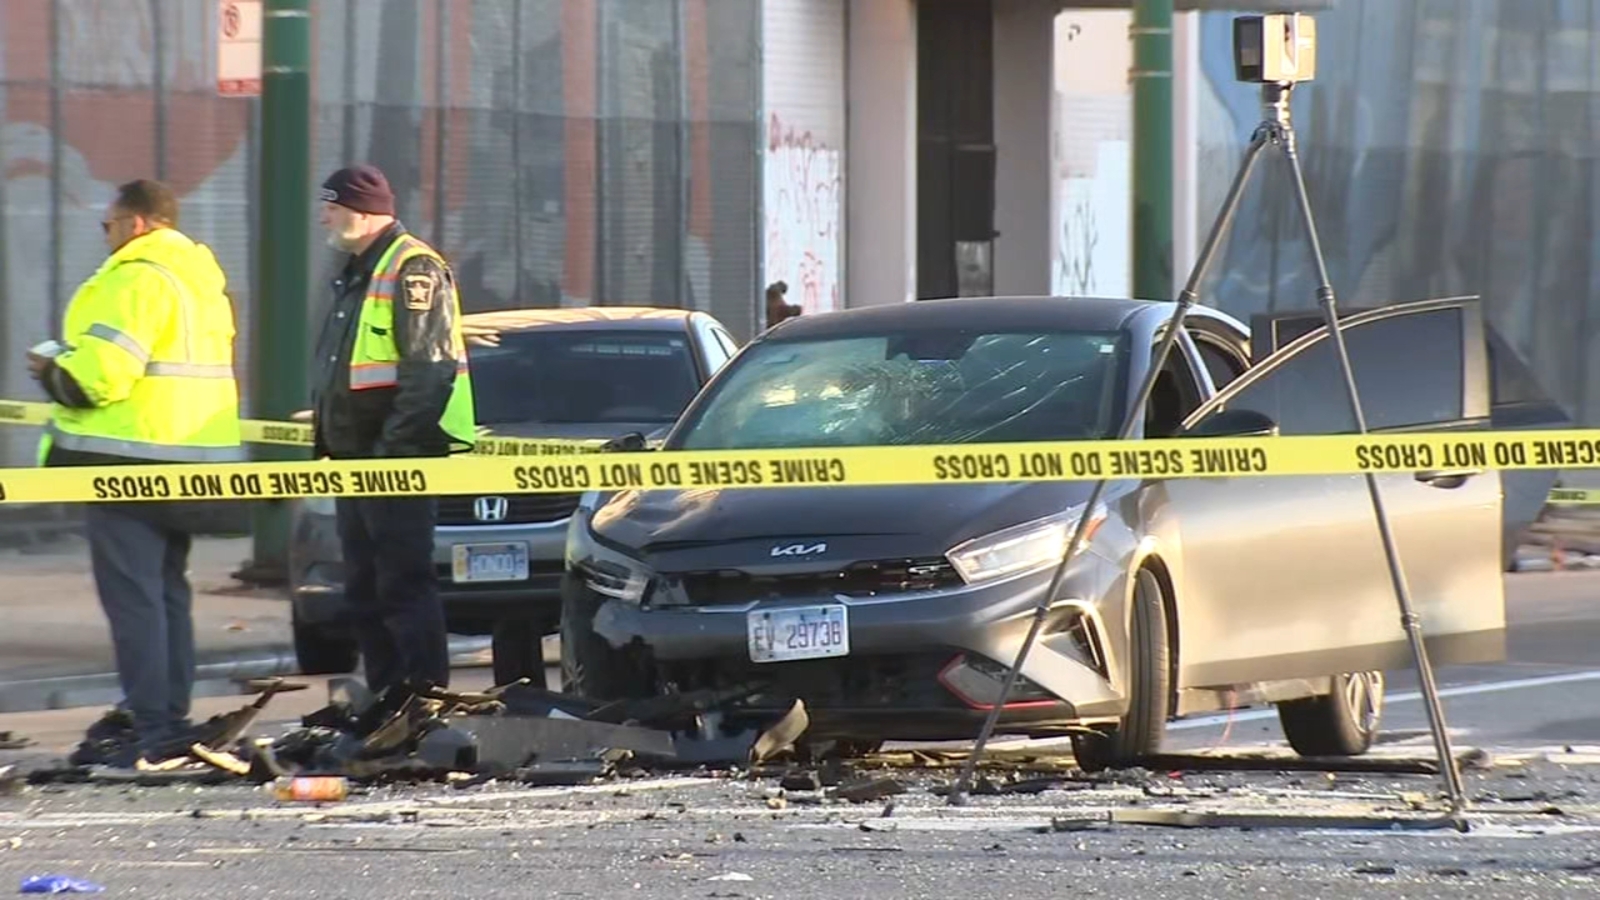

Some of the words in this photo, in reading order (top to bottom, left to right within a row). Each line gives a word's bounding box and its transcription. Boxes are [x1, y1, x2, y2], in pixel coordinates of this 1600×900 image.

[1019, 453, 1063, 477] NOT
[1071, 452, 1101, 476] DO
[1110, 450, 1184, 475] SCENE
[1191, 447, 1267, 473] CRIME
[1355, 444, 1433, 469] CROSS
[1442, 443, 1486, 467] NOT
[1494, 442, 1526, 465] DO
[514, 465, 590, 489] CROSS
[599, 463, 643, 487] NOT
[651, 463, 682, 486] DO
[689, 460, 763, 486] SCENE
[770, 458, 845, 483] CRIME
[933, 454, 1010, 480] CROSS
[93, 475, 171, 499] CROSS
[179, 474, 223, 497] NOT
[230, 473, 262, 496] DO
[268, 471, 344, 495] SCENE
[350, 469, 427, 493] CRIME
